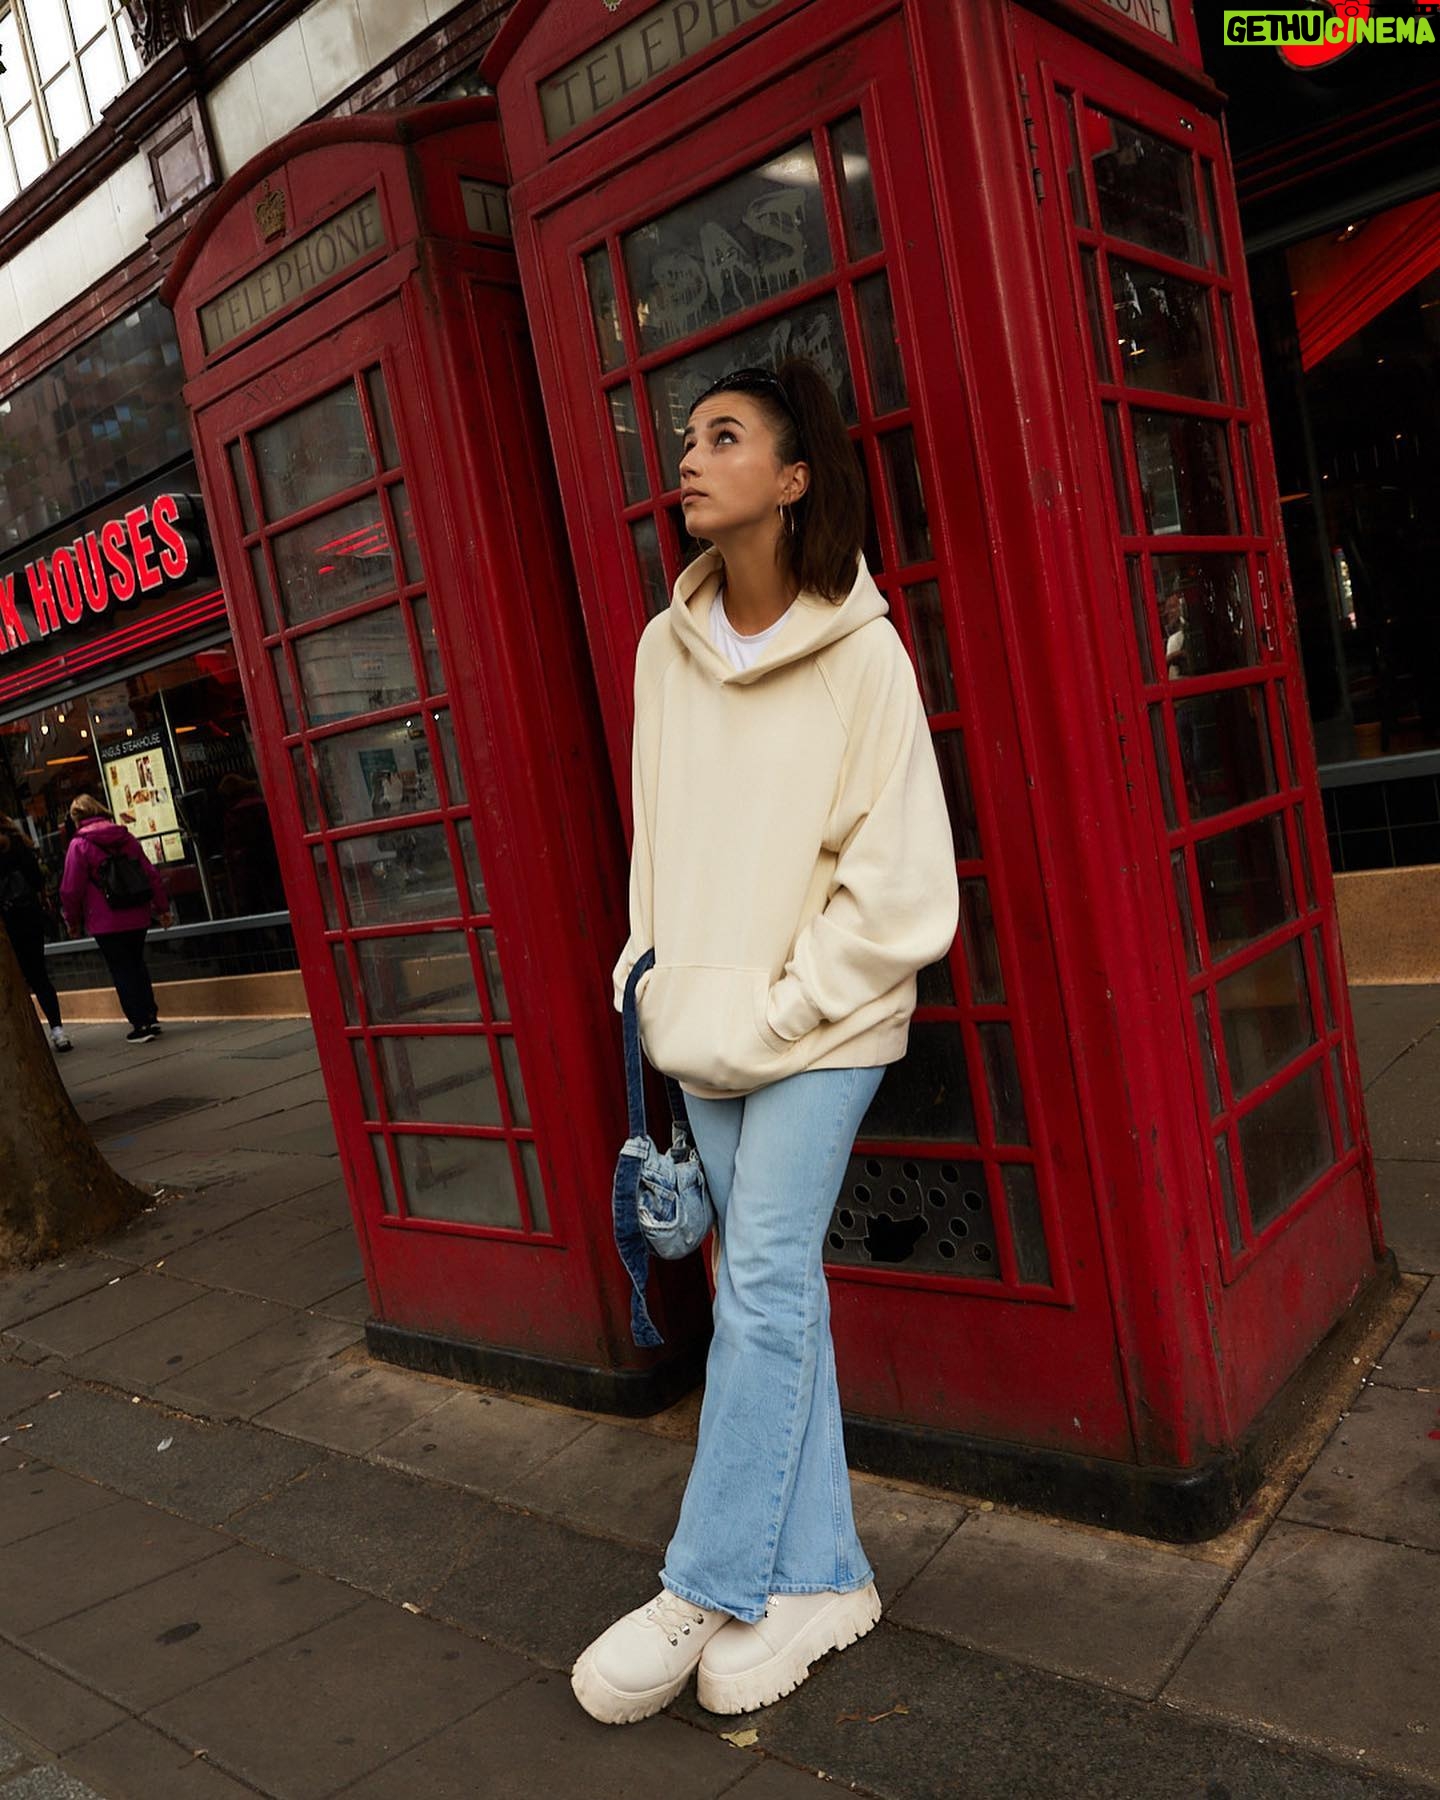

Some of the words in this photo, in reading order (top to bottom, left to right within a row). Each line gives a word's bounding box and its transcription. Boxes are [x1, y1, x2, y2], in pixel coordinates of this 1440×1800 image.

[208, 203, 380, 342] TELEPHONE
[24, 493, 188, 637] HOUSES
[1258, 570, 1274, 651] PULL
[101, 744, 121, 758] ANGUS
[122, 732, 161, 753] STEAKHOUSE
